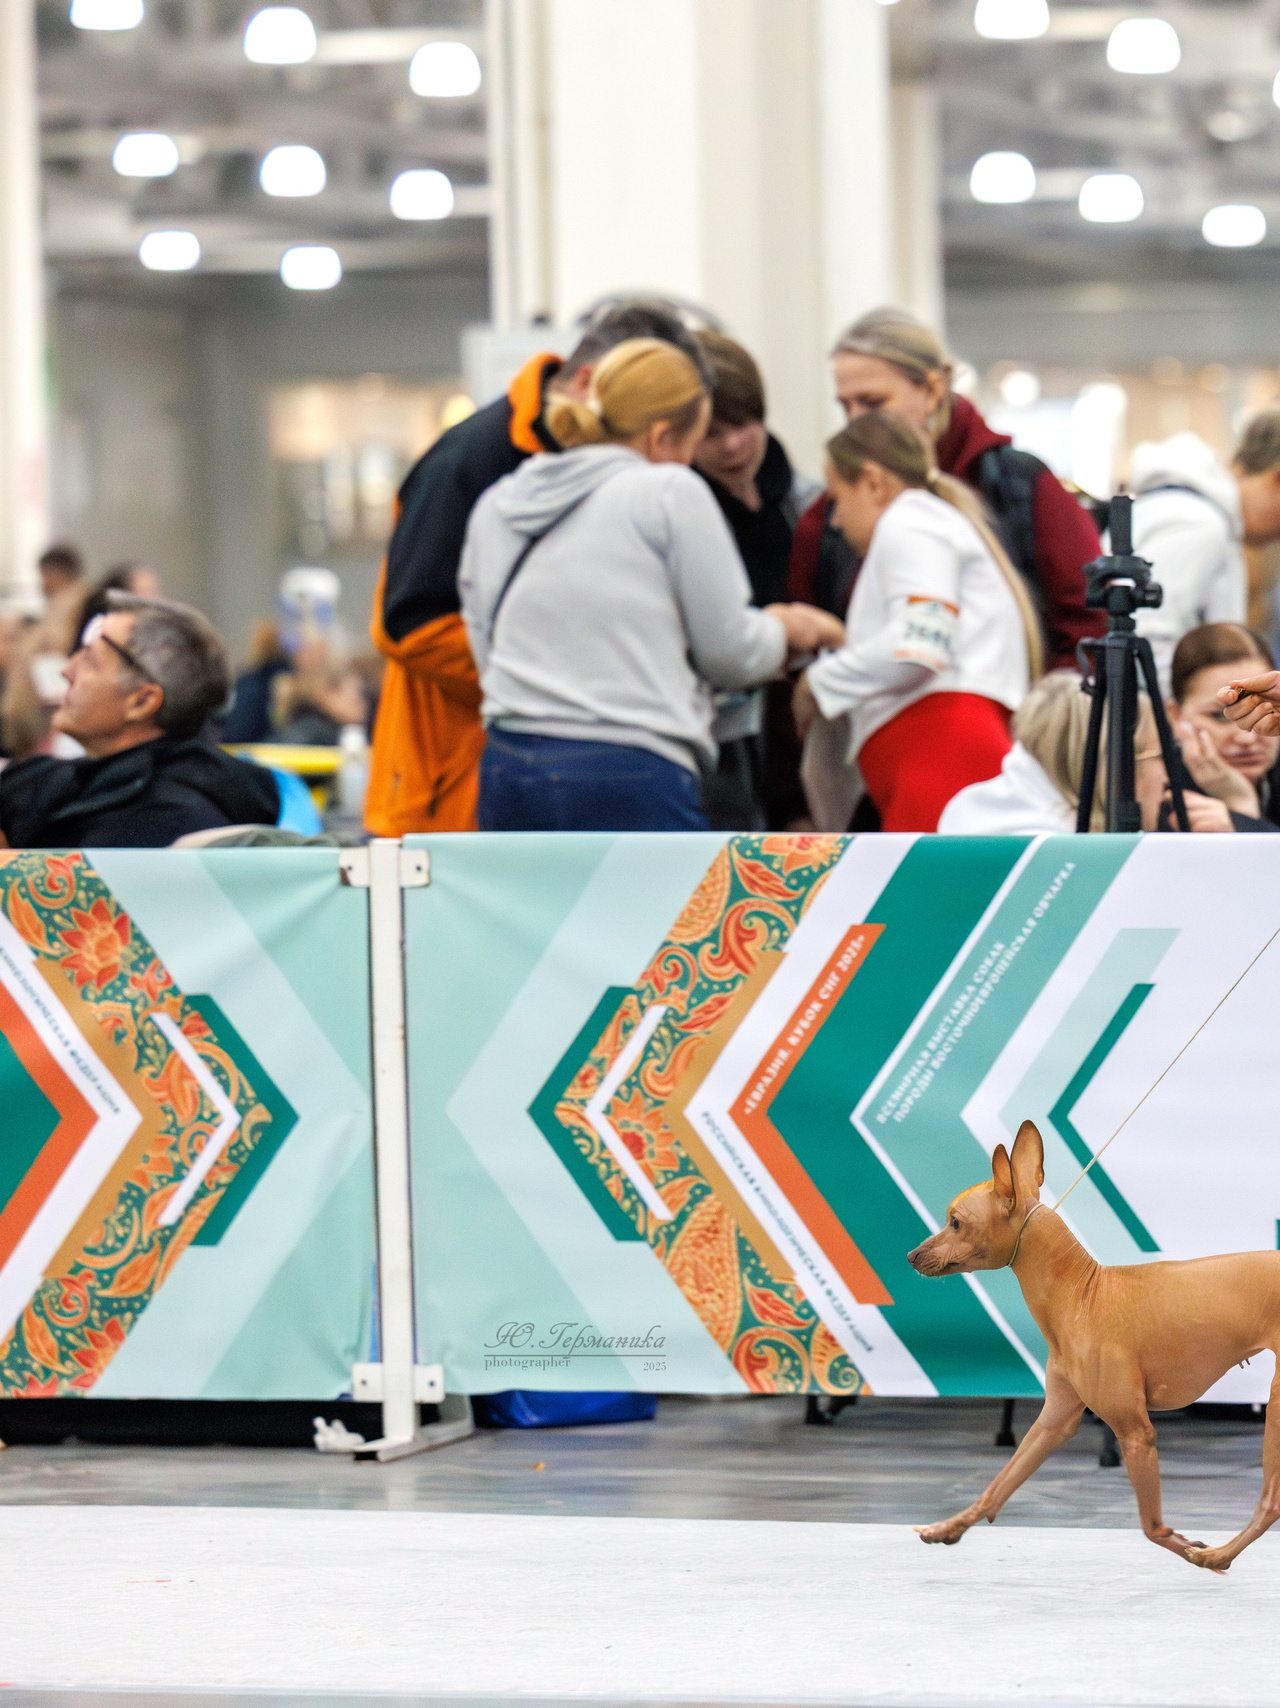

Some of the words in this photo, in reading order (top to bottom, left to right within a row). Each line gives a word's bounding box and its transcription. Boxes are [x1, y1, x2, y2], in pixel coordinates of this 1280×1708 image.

[1032, 860, 1076, 918] ОВЧАРКА
[972, 941, 1005, 984] СОБАК
[786, 999, 822, 1046] КУБОК
[817, 971, 841, 1000] СНГ
